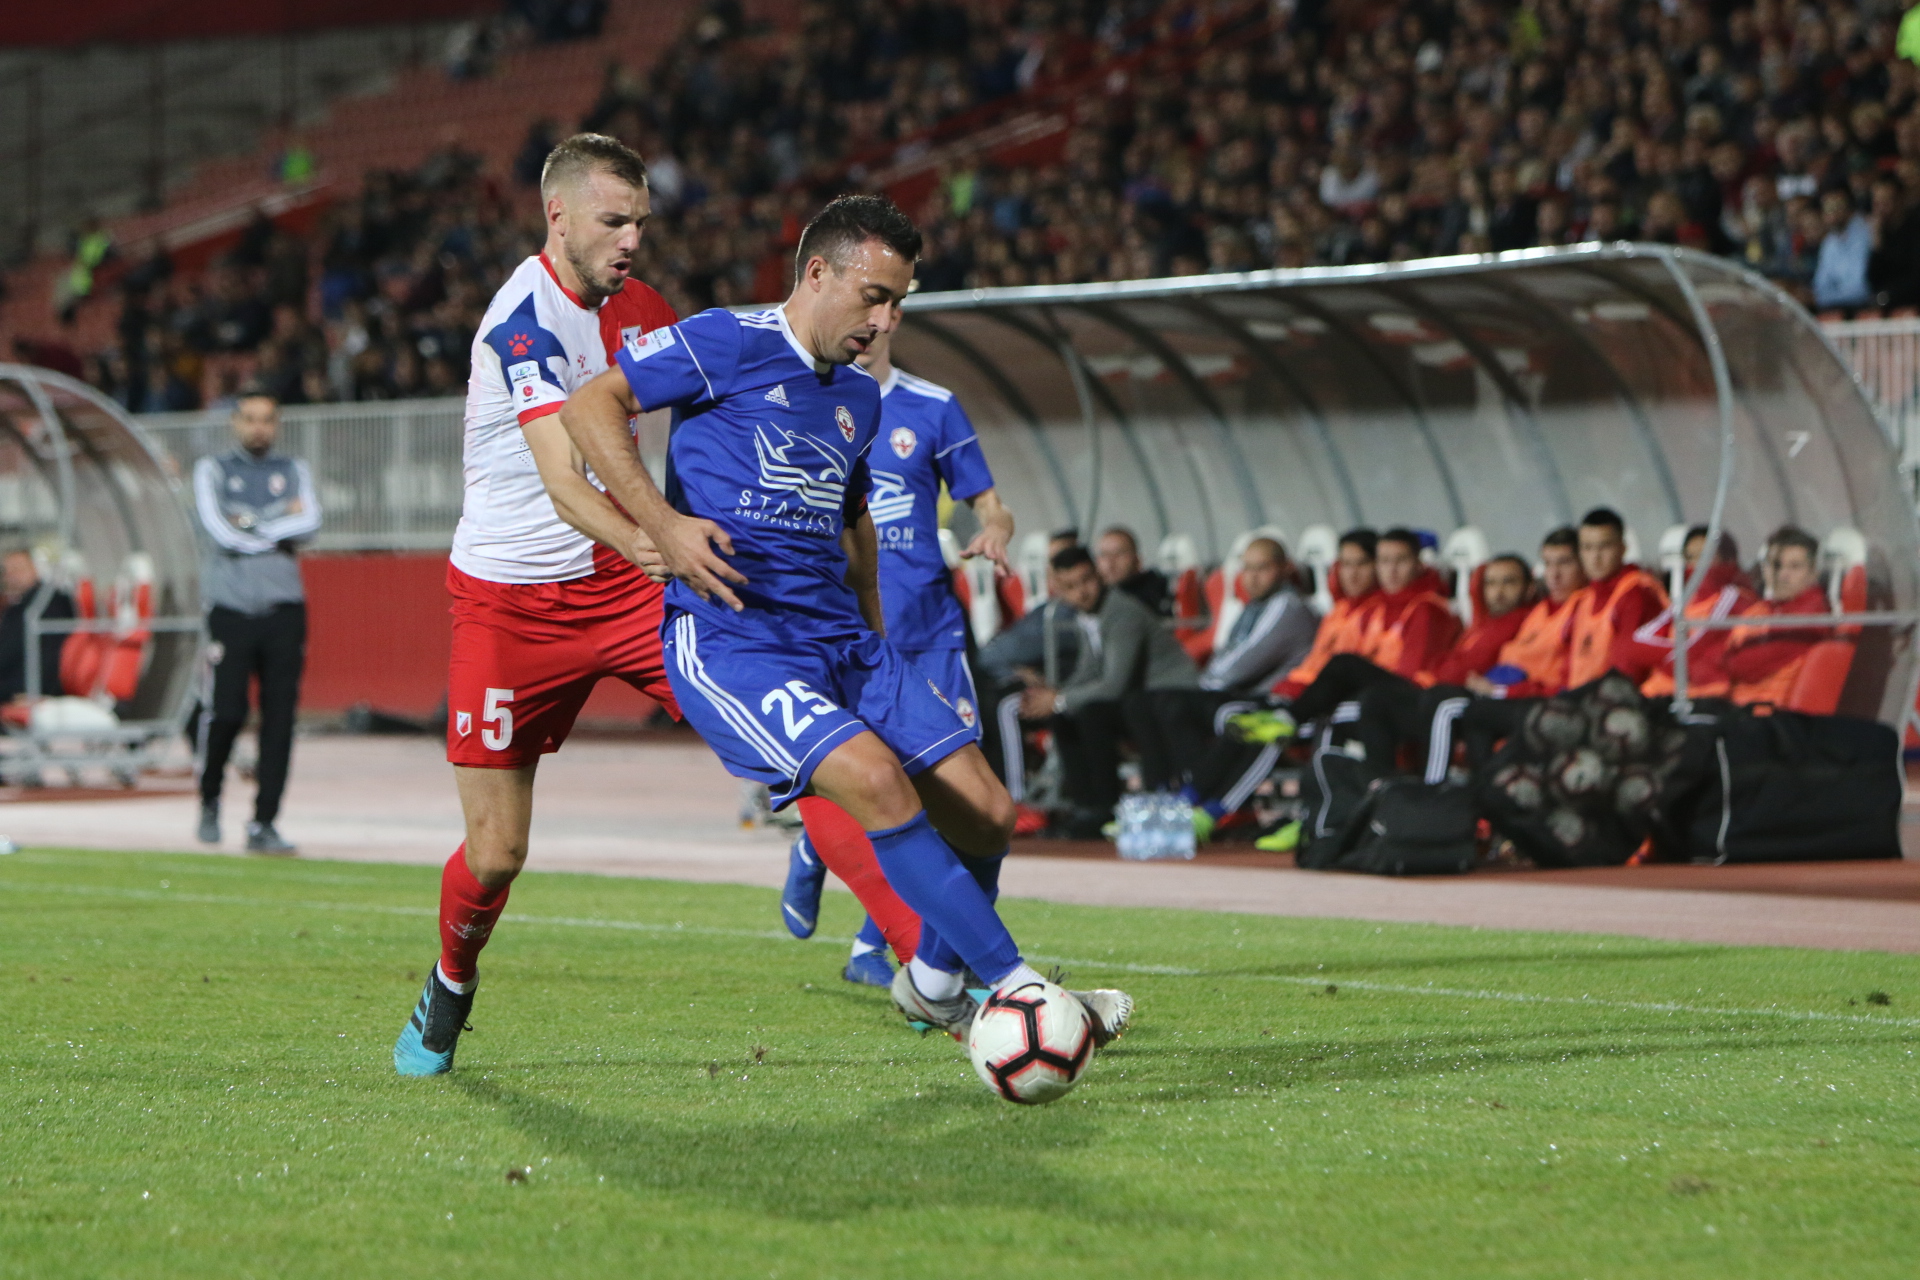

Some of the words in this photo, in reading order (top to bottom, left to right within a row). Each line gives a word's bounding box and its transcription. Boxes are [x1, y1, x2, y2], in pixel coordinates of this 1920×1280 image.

[764, 394, 790, 408] adidas
[734, 507, 800, 530] SHOPPING
[481, 687, 515, 751] 5
[761, 680, 838, 742] 25
